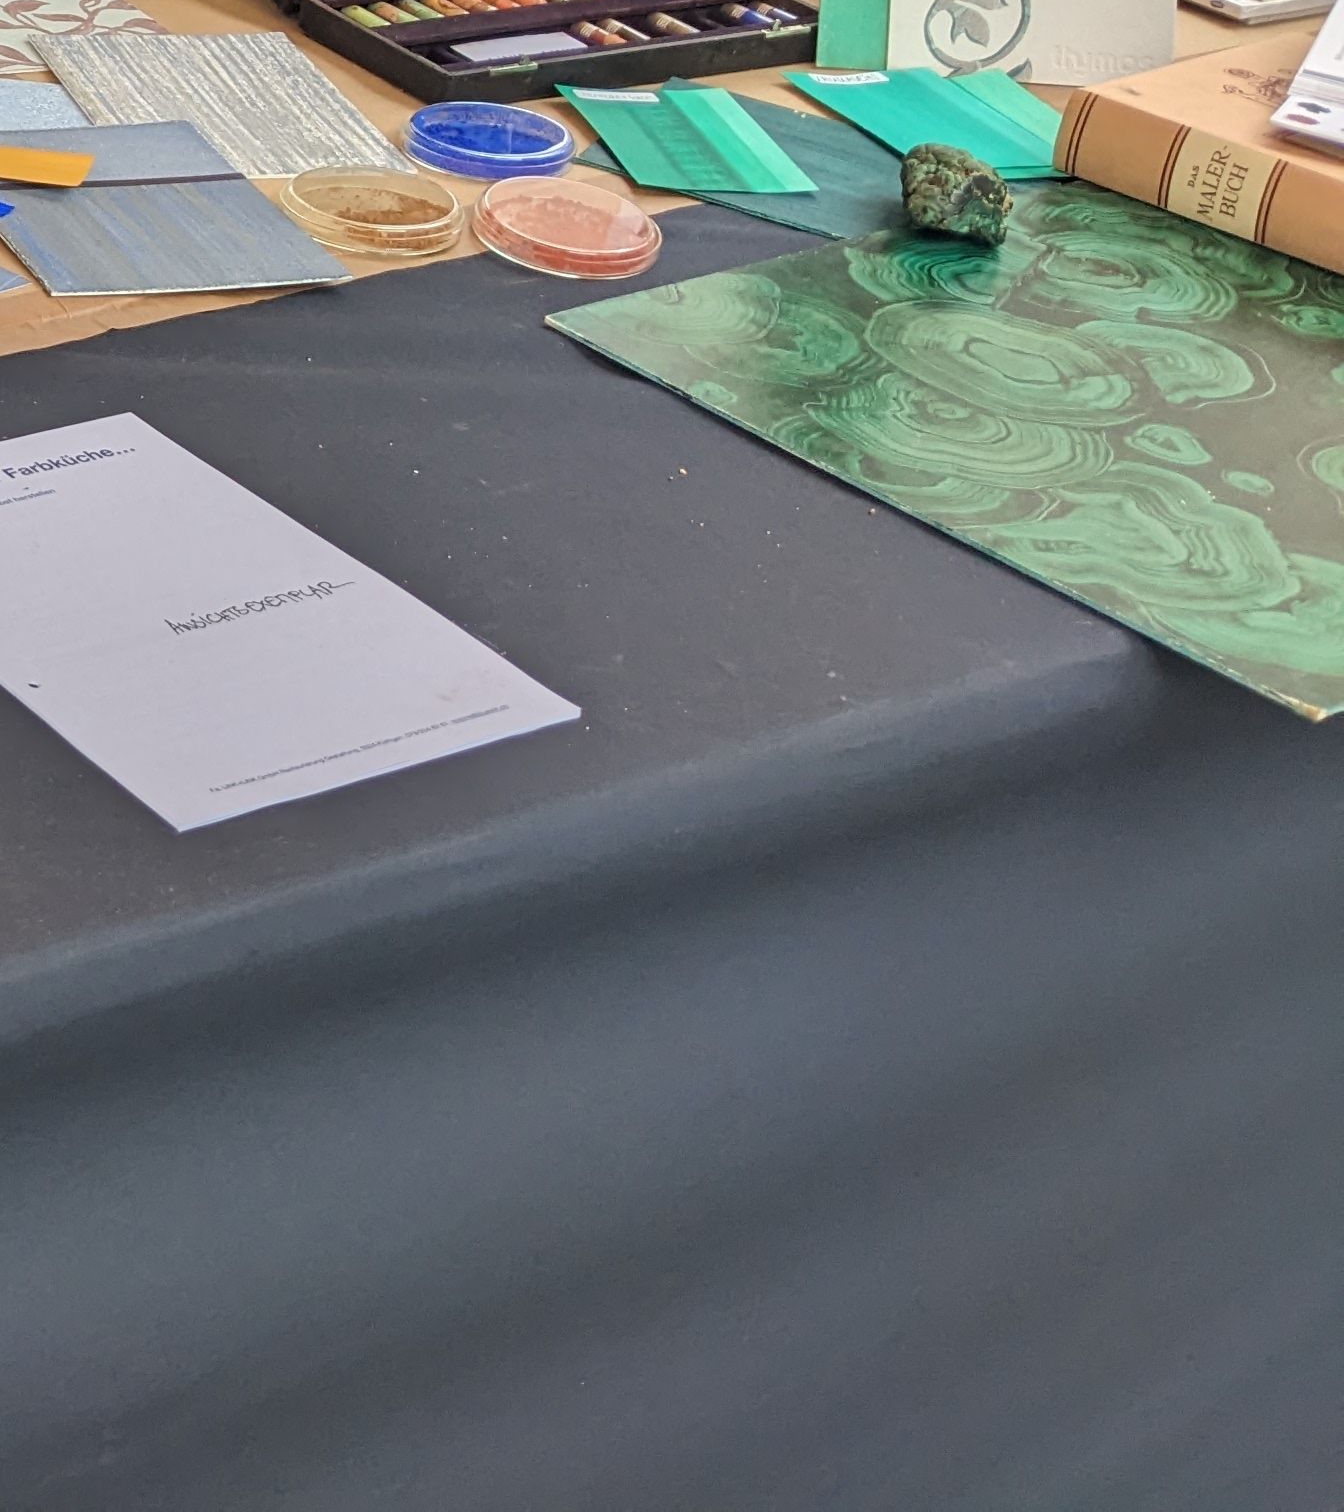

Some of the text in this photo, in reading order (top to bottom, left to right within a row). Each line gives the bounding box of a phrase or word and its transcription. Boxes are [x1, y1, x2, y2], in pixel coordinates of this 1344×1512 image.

[1187, 165, 1200, 188] DAS
[1218, 163, 1249, 218] BUCH
[2, 445, 137, 480] Farbküche...
